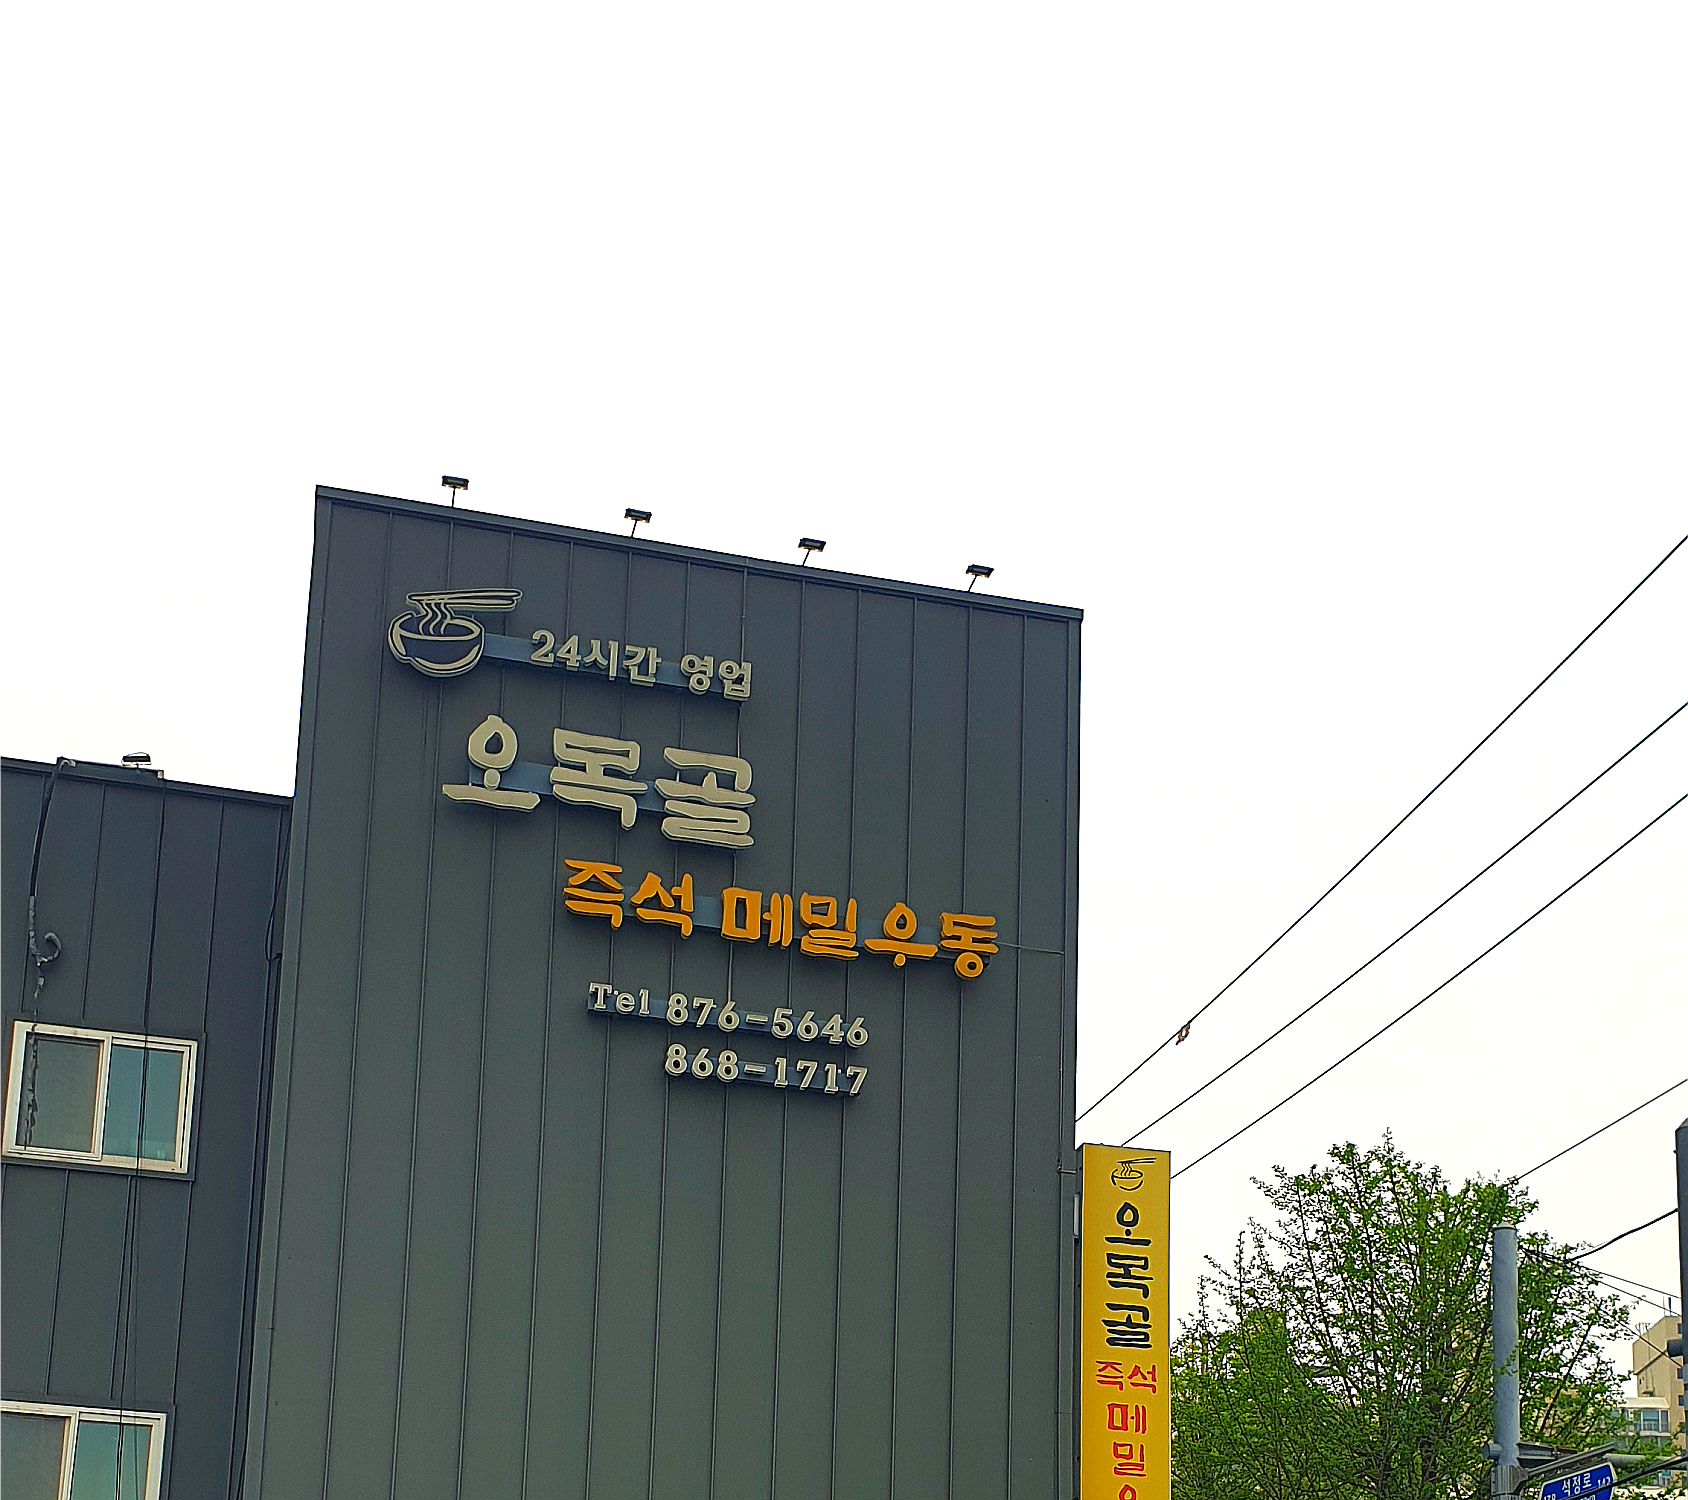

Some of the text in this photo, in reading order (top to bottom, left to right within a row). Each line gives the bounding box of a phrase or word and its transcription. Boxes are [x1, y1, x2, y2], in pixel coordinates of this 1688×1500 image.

[530, 629, 753, 702] 24시간 영업
[442, 714, 756, 848] 오목골
[563, 858, 695, 938] 즉석
[588, 982, 869, 1048] Tel 876-5646
[666, 1044, 869, 1097] 868-1717
[1101, 1201, 1154, 1350] 오목골
[1095, 1359, 1157, 1394] 즉석
[1562, 1472, 1592, 1496] 석정로
